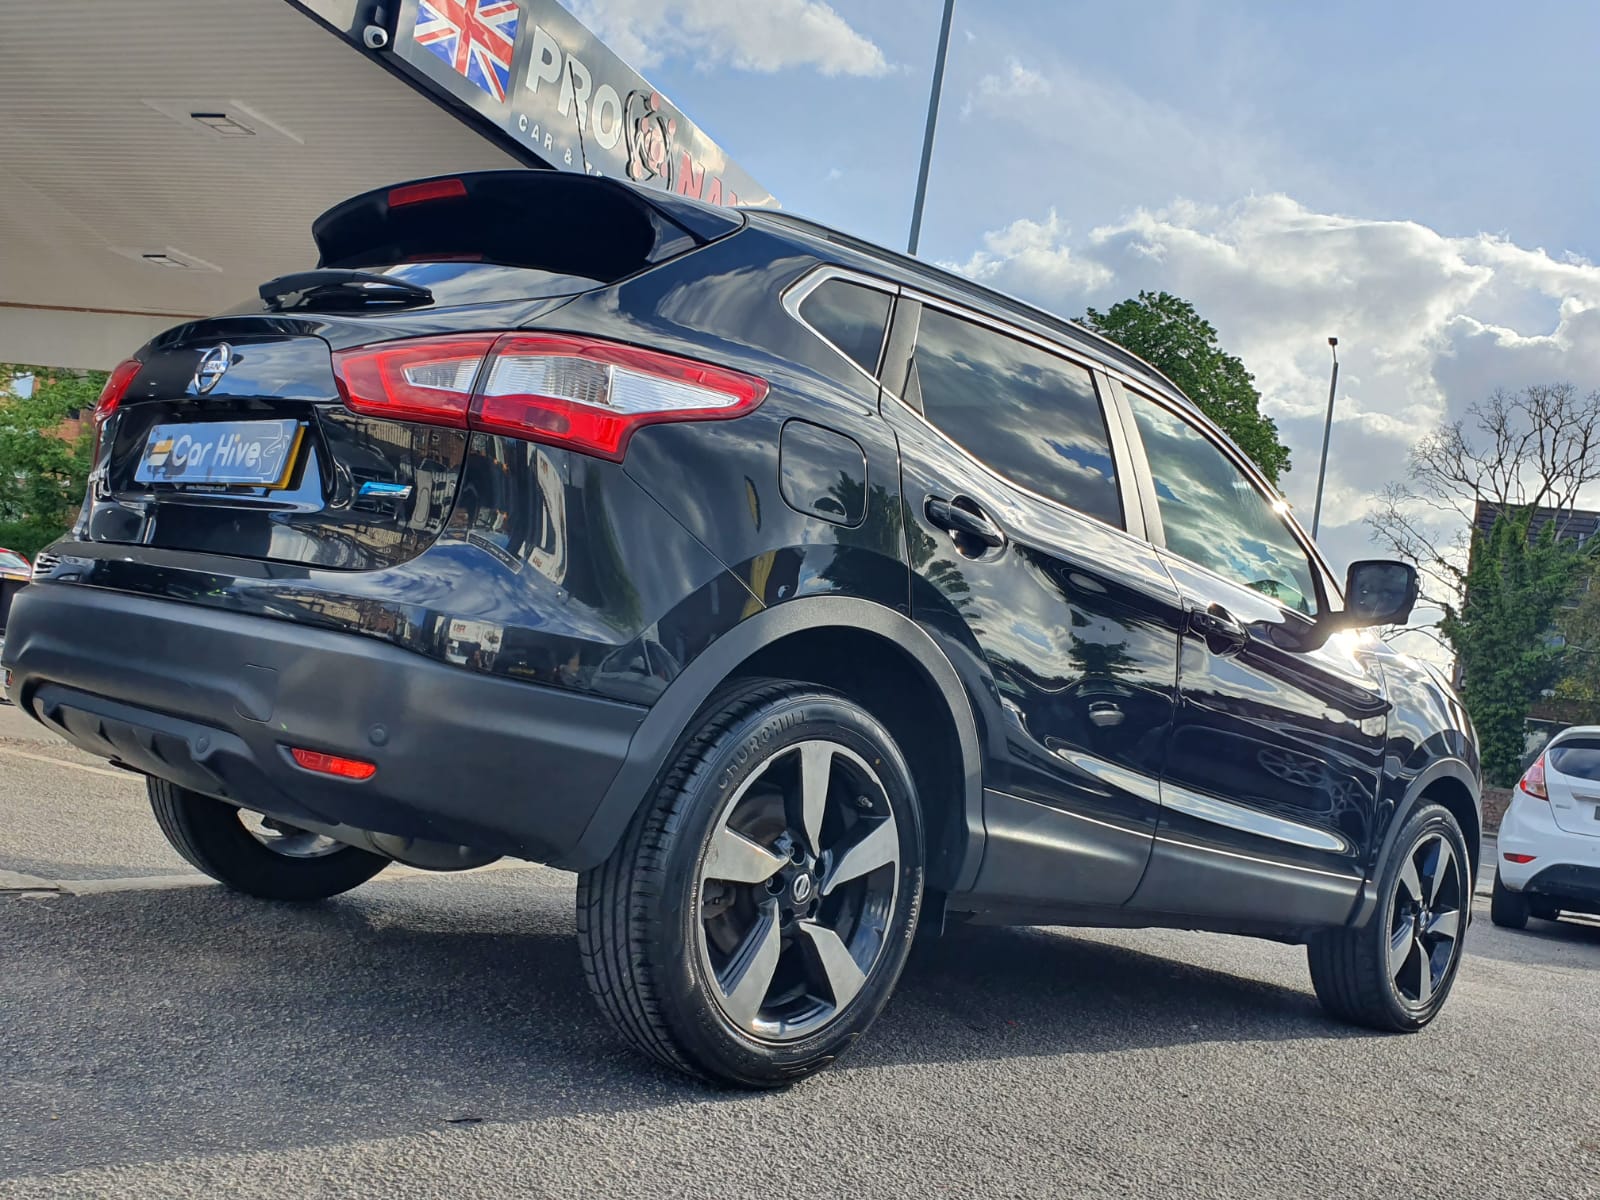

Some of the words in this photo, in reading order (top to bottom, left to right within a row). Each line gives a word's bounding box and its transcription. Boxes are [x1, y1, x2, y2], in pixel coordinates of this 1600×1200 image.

[525, 25, 623, 150] PRO
[518, 113, 553, 151] CAR
[564, 148, 573, 166] &
[171, 434, 213, 467] Car
[211, 433, 262, 467] Hive
